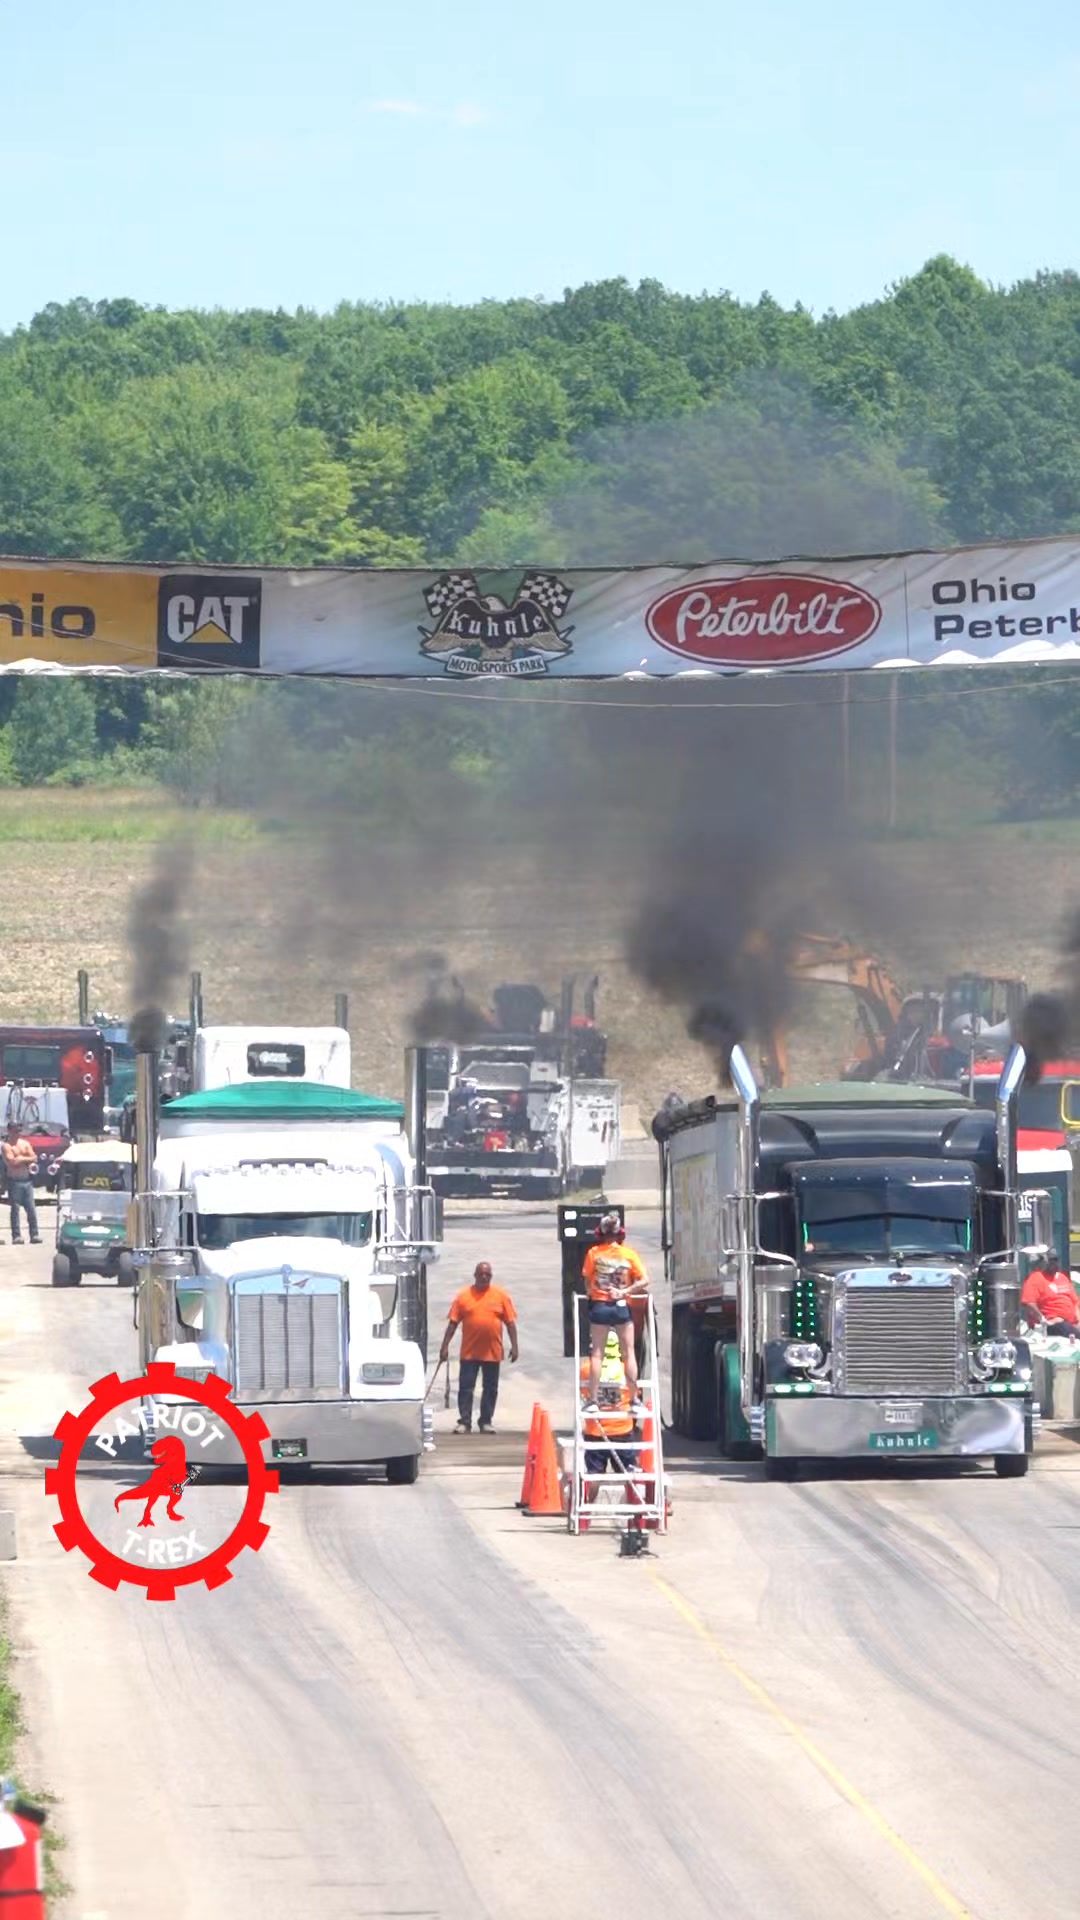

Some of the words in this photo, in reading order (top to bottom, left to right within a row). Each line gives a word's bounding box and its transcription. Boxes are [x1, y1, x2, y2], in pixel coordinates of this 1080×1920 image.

[932, 576, 1036, 605] Ohio
[167, 594, 249, 644] CAT
[449, 610, 543, 637] Kuhnle
[676, 591, 862, 643] Peterbilt
[450, 658, 517, 673] MOTORSPORTS
[519, 659, 544, 673] PARK
[876, 1434, 930, 1447] Kuhnle
